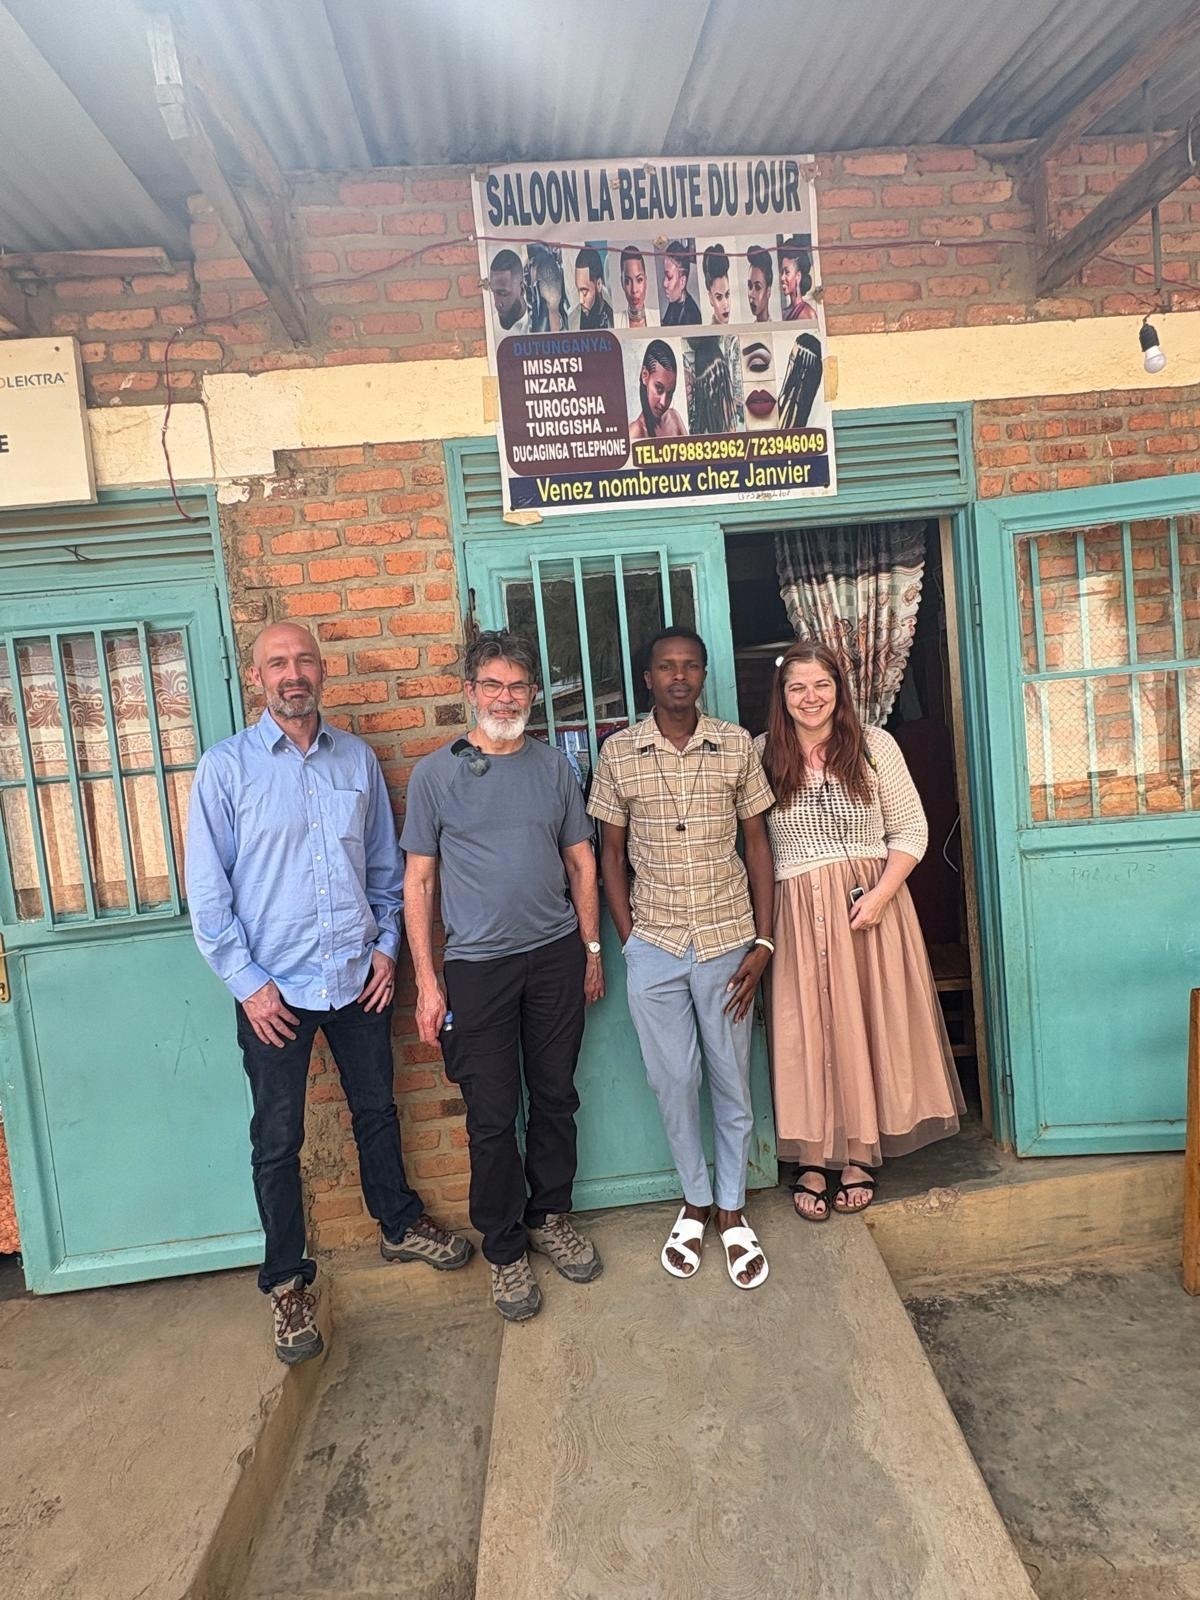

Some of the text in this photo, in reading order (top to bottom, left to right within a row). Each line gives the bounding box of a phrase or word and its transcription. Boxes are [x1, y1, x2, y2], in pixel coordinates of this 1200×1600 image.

[486, 159, 801, 227] SALOON LA BEAUTE DU JOUR
[513, 338, 612, 356] DUTUNGANYA:
[523, 357, 583, 375] IMISATSI
[525, 377, 577, 395] INZARA
[525, 396, 606, 419] TUROGOSHA
[526, 418, 602, 438] TURIGISHA
[513, 438, 627, 462] DUCAGINGA TELEPHONE
[536, 460, 811, 502] Venez nombreux chez Janvier
